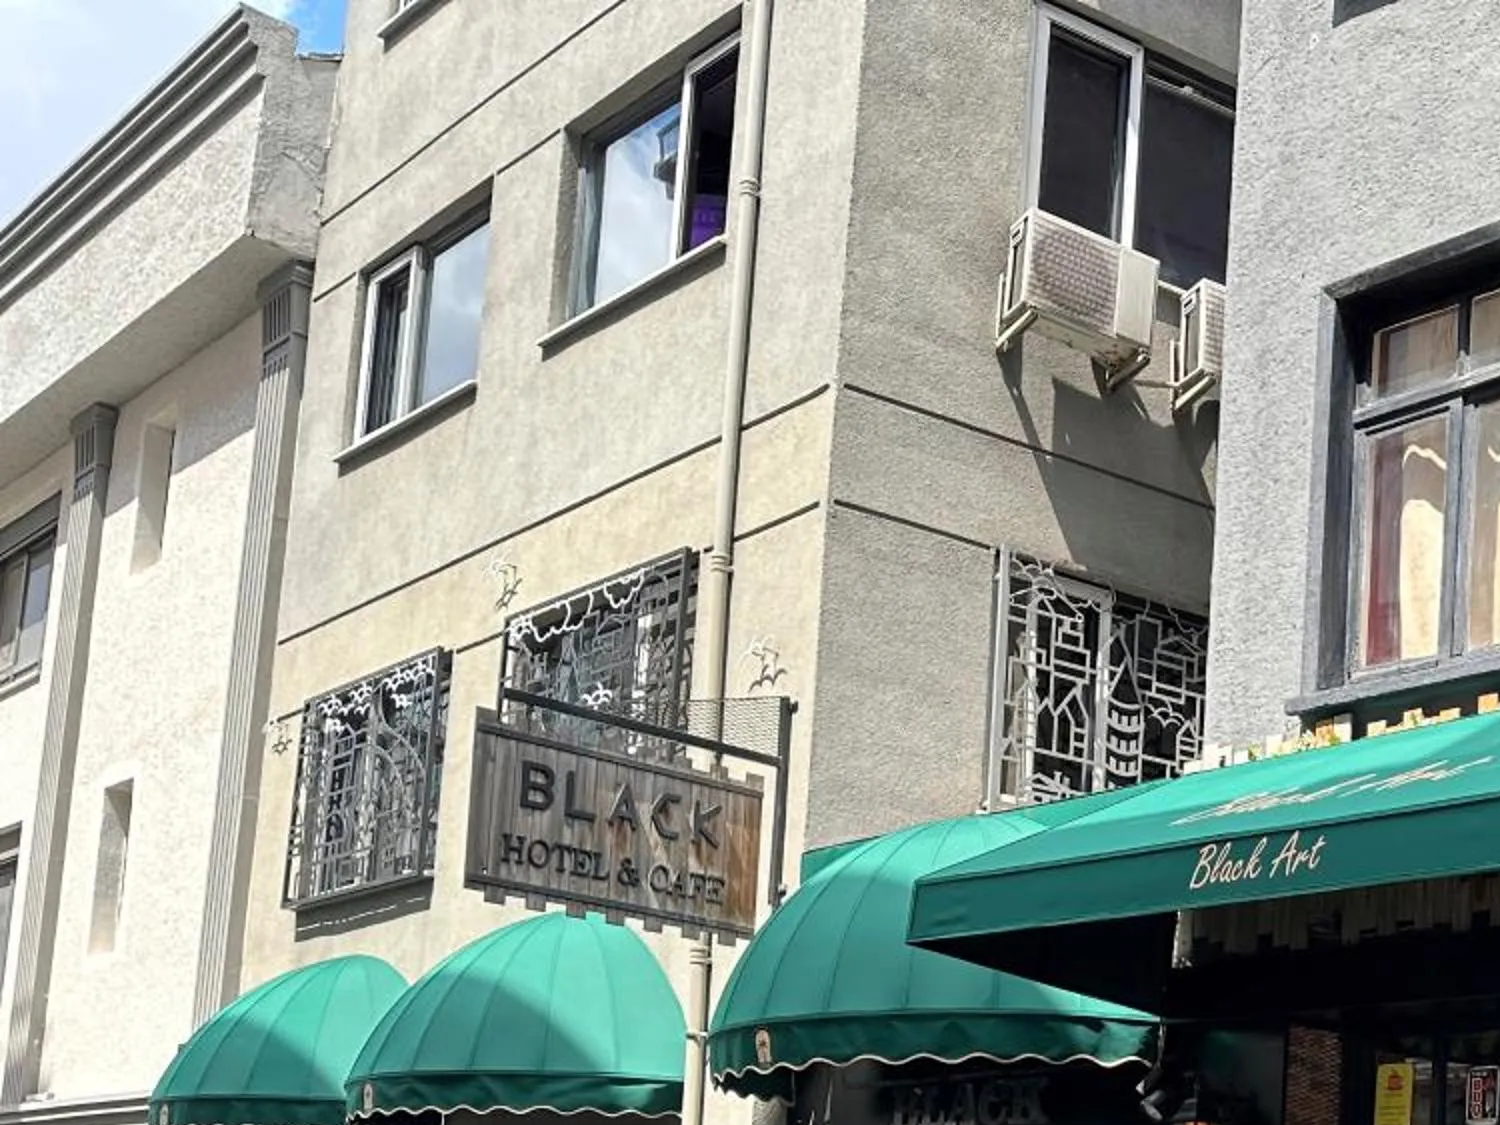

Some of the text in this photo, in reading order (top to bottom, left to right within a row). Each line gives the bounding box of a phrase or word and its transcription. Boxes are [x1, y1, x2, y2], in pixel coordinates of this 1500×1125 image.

[518, 759, 723, 850] BLACK
[501, 833, 726, 906] HOTEL & CAFE
[1189, 830, 1328, 891] Black Art
